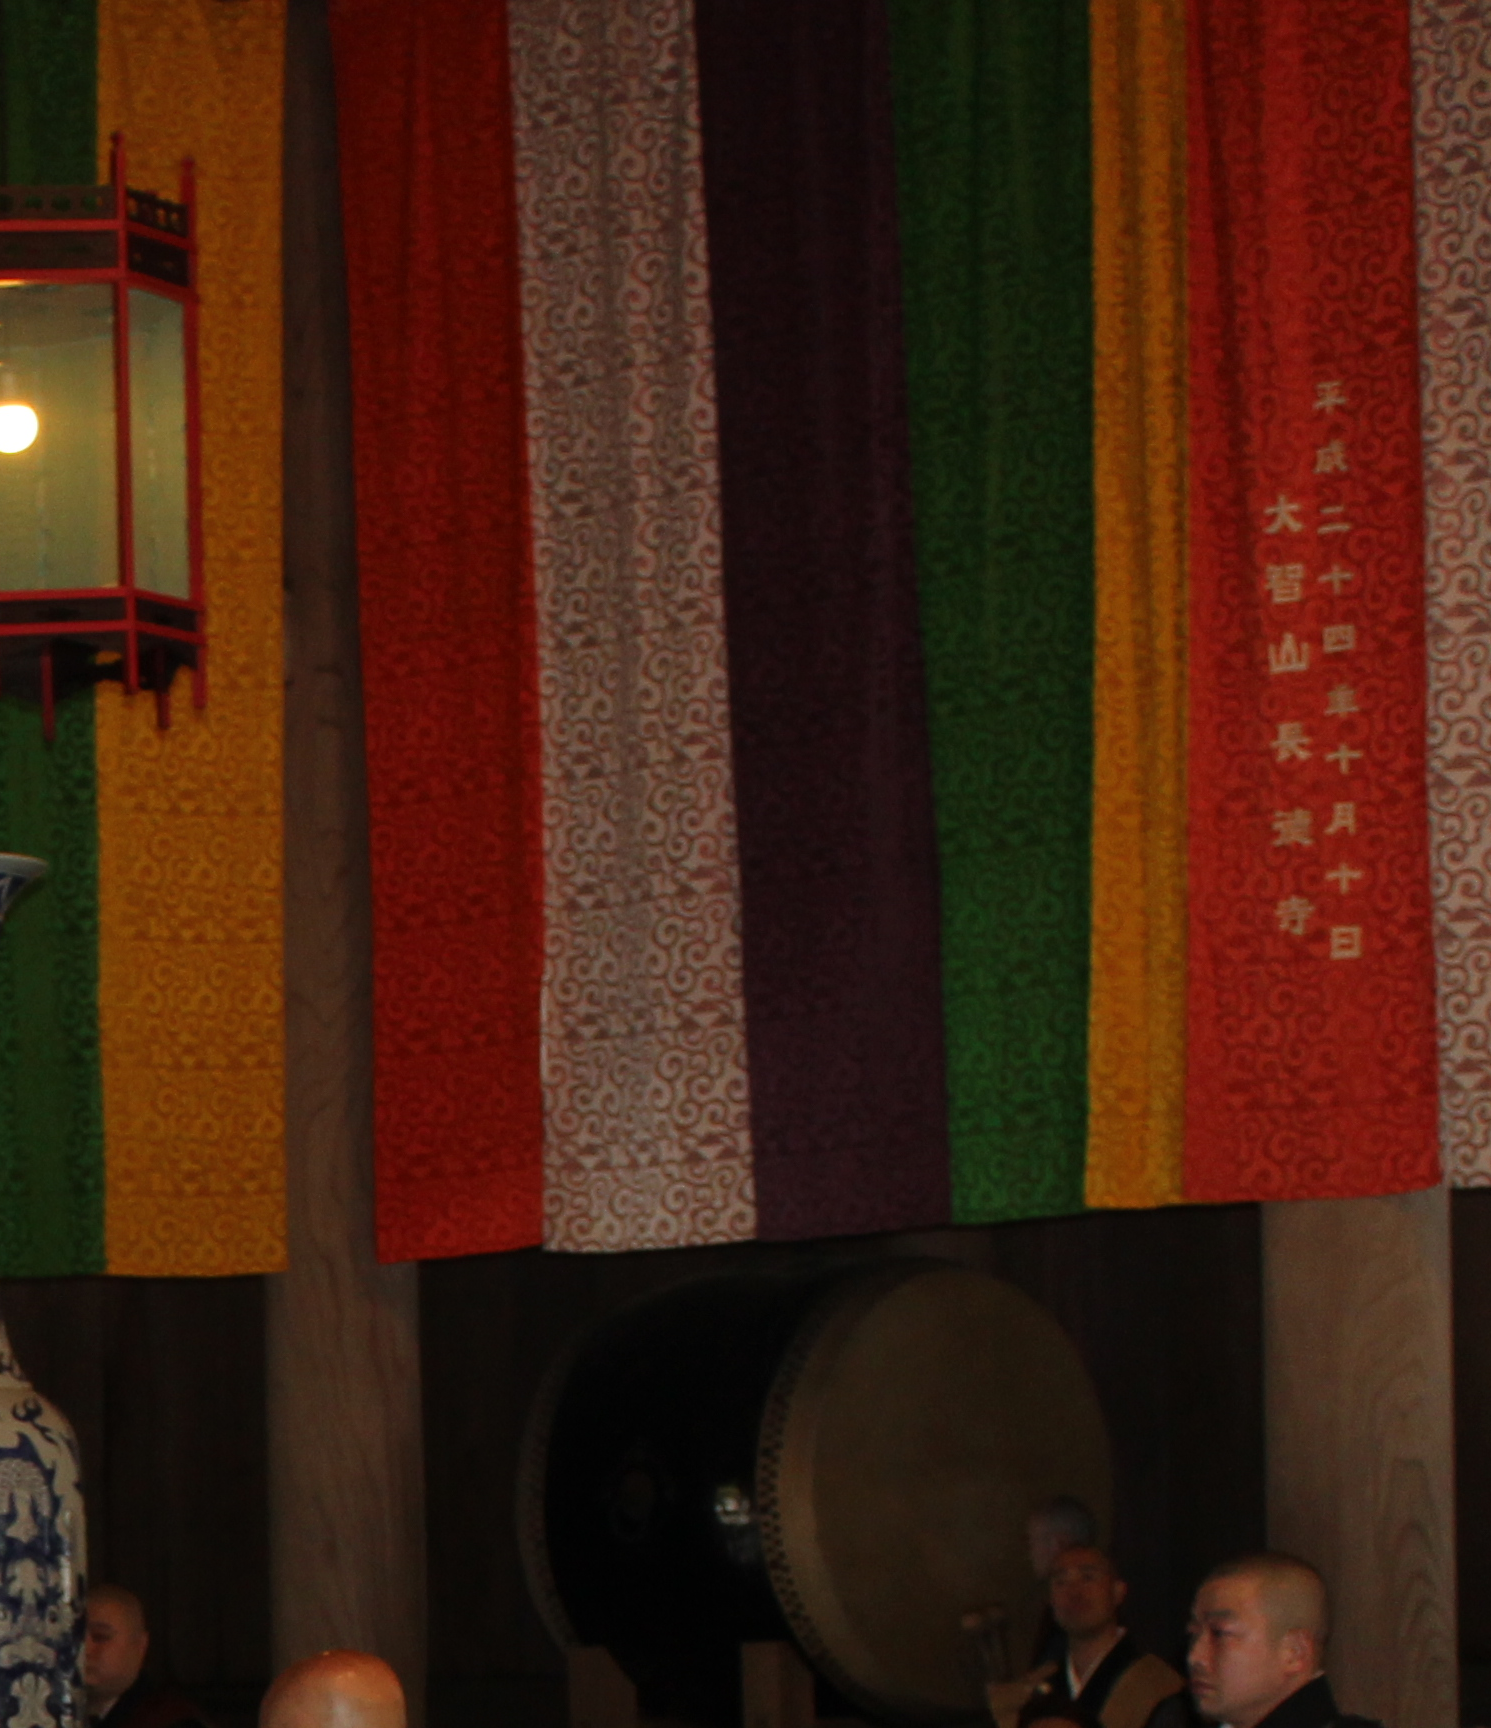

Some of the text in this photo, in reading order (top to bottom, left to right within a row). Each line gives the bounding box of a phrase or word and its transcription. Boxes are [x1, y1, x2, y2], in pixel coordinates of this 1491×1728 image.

[1312, 381, 1362, 959] 平成二十四年十月十日
